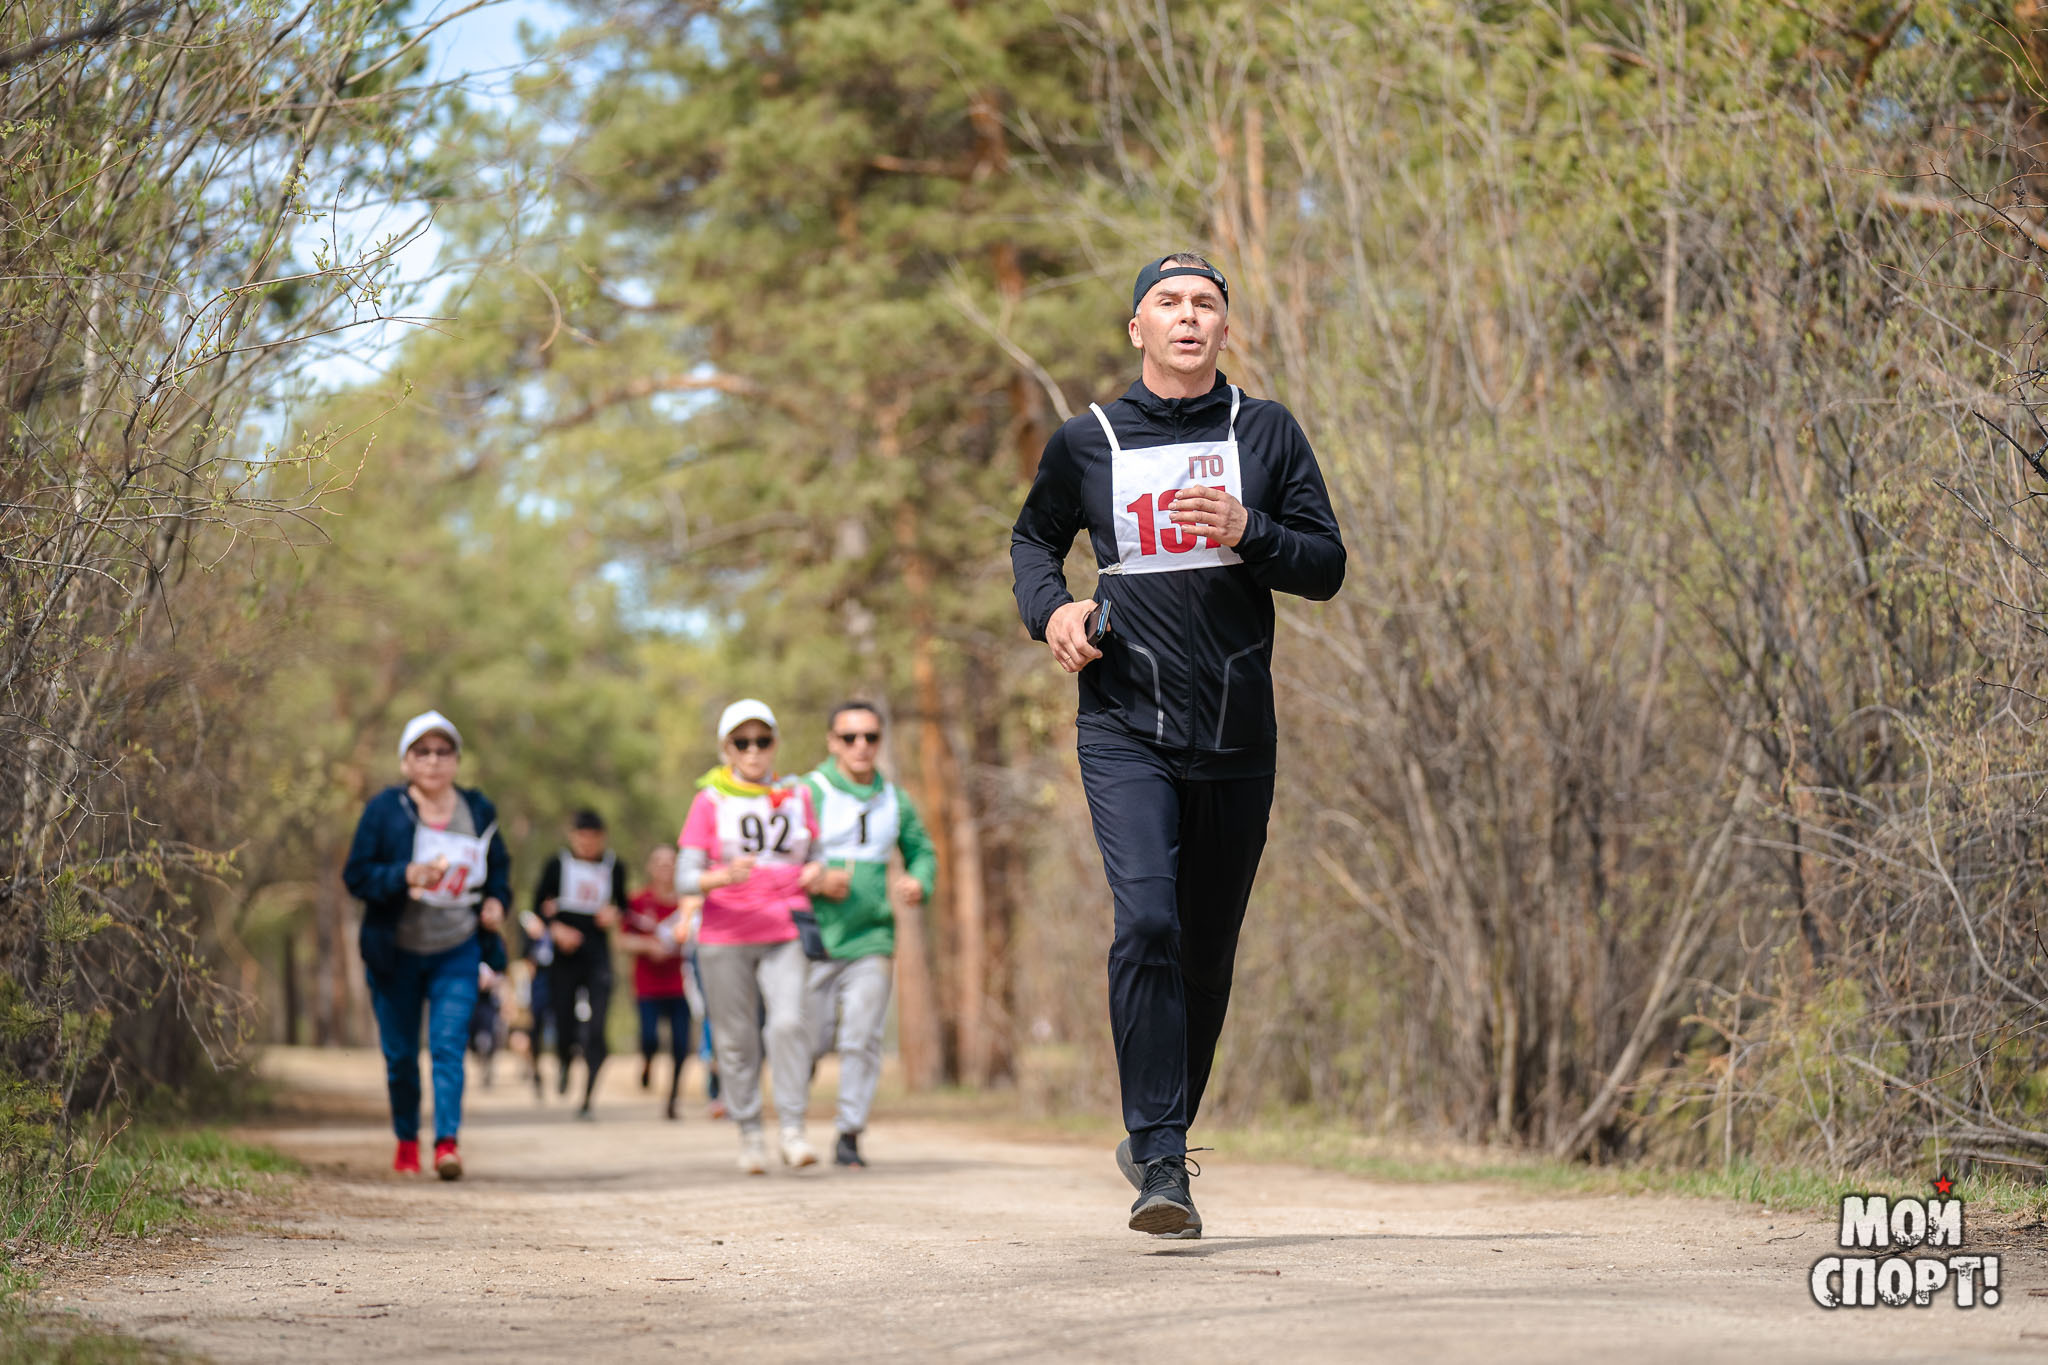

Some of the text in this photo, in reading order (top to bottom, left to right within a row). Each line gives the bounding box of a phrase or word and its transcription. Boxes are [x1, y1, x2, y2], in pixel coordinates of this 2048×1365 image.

[1188, 454, 1224, 479] ГТО
[740, 813, 792, 854] 92
[857, 811, 870, 844] 1
